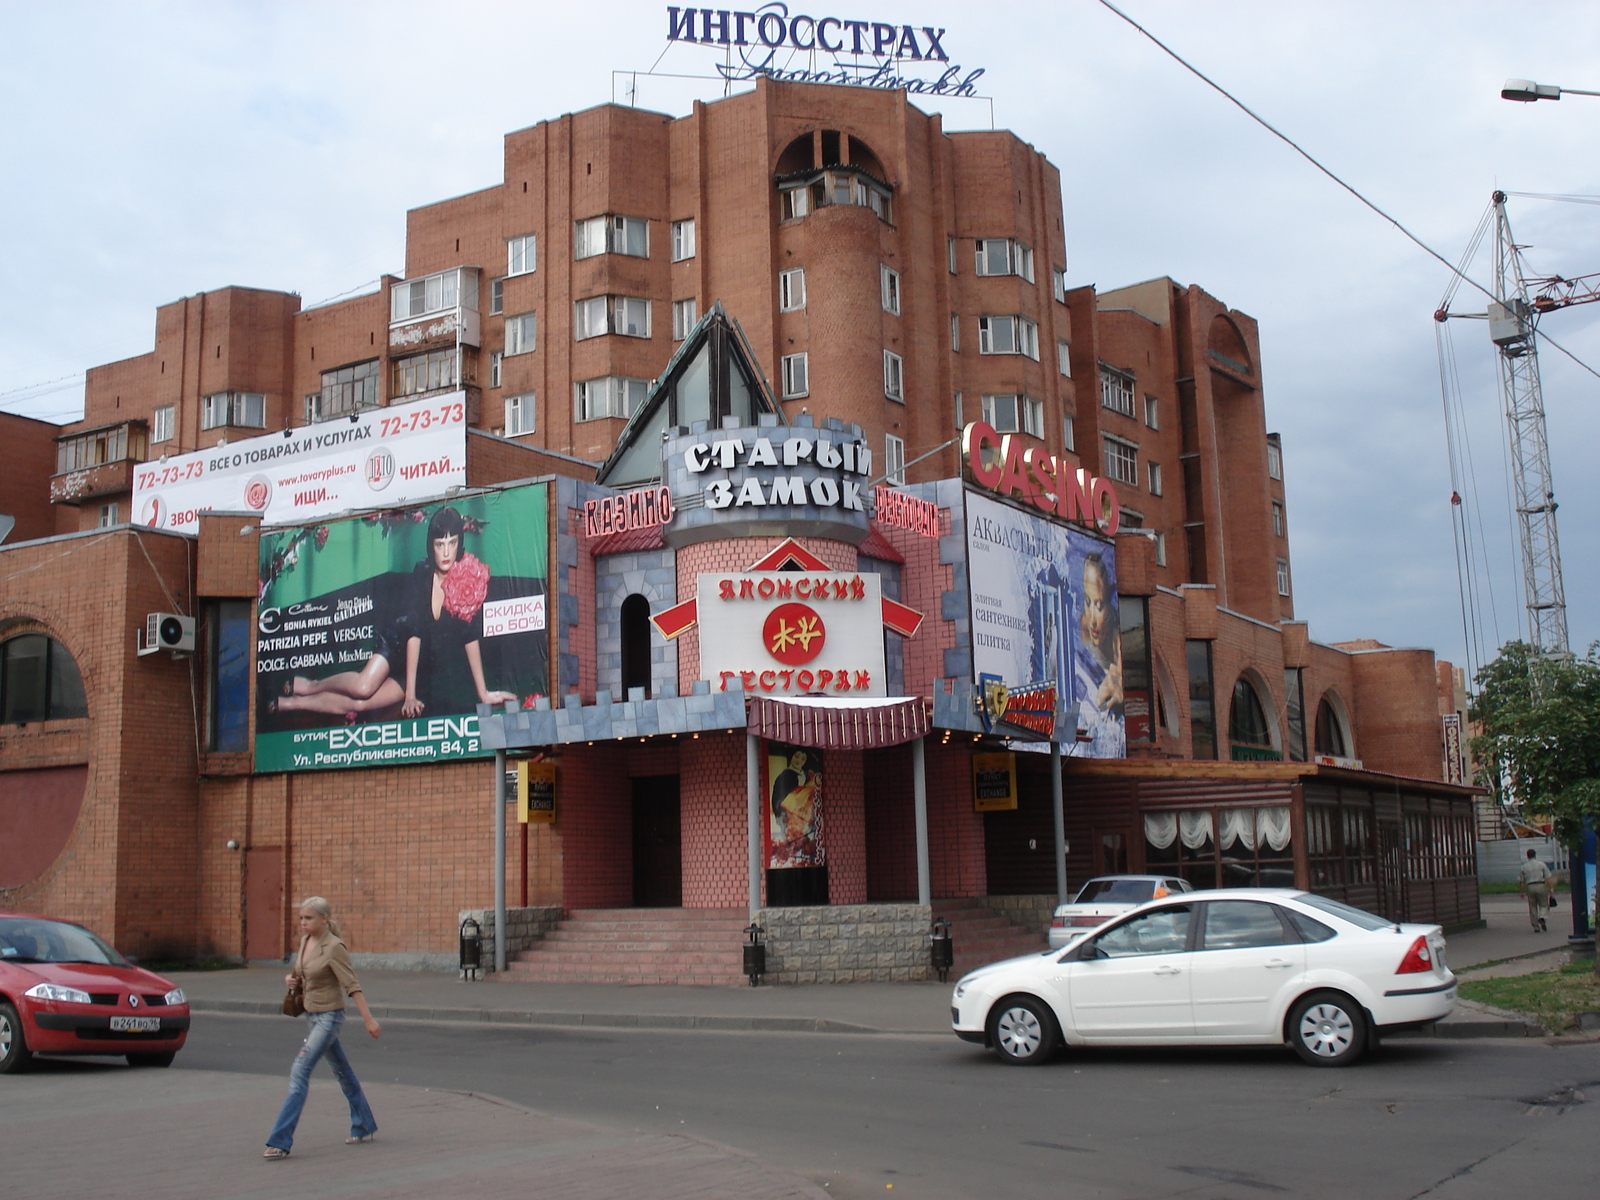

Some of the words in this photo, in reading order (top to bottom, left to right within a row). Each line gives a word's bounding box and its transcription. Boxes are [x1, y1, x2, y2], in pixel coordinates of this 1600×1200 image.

[666, 2, 949, 62] ИНГОССТРАХ
[138, 460, 204, 490] 72-73-73
[209, 456, 230, 472] ВСЕ
[232, 454, 241, 466] О
[245, 441, 299, 464] ТОВАРАХ
[303, 440, 312, 451] И
[316, 425, 371, 447] УСЛУГАХ
[380, 403, 464, 437] 72-73-73
[684, 437, 872, 476] СТАРЫЙ
[278, 464, 356, 487] www.tovaryplus.ru
[400, 456, 466, 480] ЧИТАЙ...
[962, 421, 1120, 536] CASINO
[294, 488, 339, 506] ИЩИ...
[704, 476, 864, 512] ЗАМОК
[584, 485, 673, 537] КАЗИНО
[875, 485, 939, 540] РЕСТОРАН
[973, 514, 1053, 562] АКВАСТИЛЬ
[719, 575, 865, 600] ЯПОНСКИЙ
[334, 600, 373, 623] GAULTIER
[485, 601, 543, 618] СКИДКА
[975, 608, 1027, 633] сантехника
[284, 620, 306, 631] SONIA
[308, 616, 332, 627] RYKIEL
[334, 625, 374, 643] VERSACE
[486, 624, 504, 636] до
[508, 615, 543, 630] 50%
[258, 635, 300, 652] PATRIZIA
[303, 631, 327, 647] PEPE
[976, 632, 1011, 651] плитка
[258, 657, 285, 673] DOLCE
[290, 651, 334, 669] GABBANA
[339, 648, 373, 663] MaxMara
[294, 731, 328, 743] БУТИК
[329, 713, 501, 749] EXCELLENC
[294, 754, 311, 766] Ул.
[315, 744, 436, 764] Республиканская,
[440, 741, 464, 755] 84,
